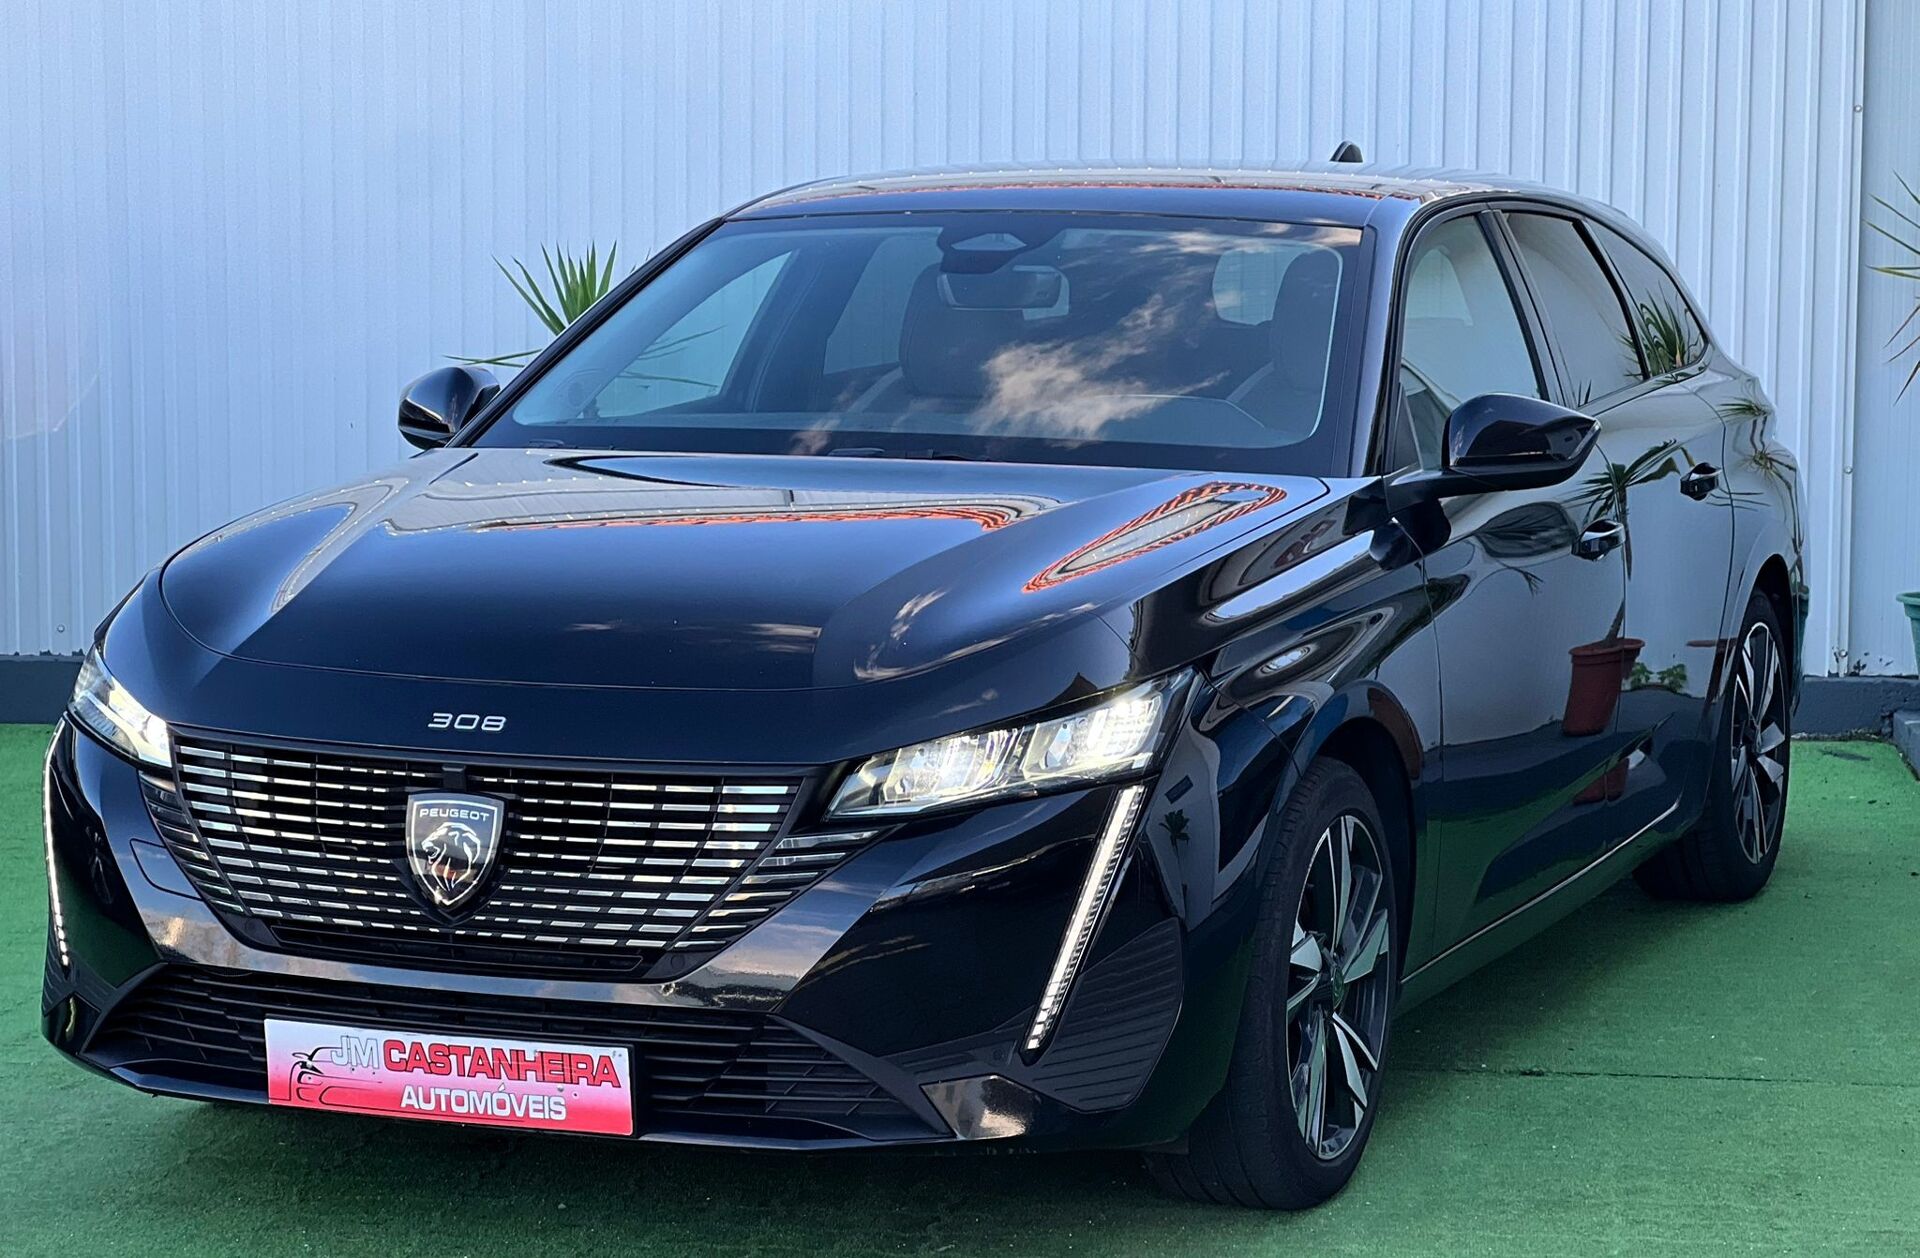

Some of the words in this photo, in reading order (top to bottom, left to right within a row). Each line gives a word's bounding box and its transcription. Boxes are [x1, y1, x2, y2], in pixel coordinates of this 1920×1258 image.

[427, 712, 507, 731] 308
[419, 808, 489, 821] PEUGEOT
[330, 1036, 379, 1069] JM
[383, 1039, 621, 1088] CASTANHEIRA
[401, 1083, 567, 1120] AUTOMÓVEIS
